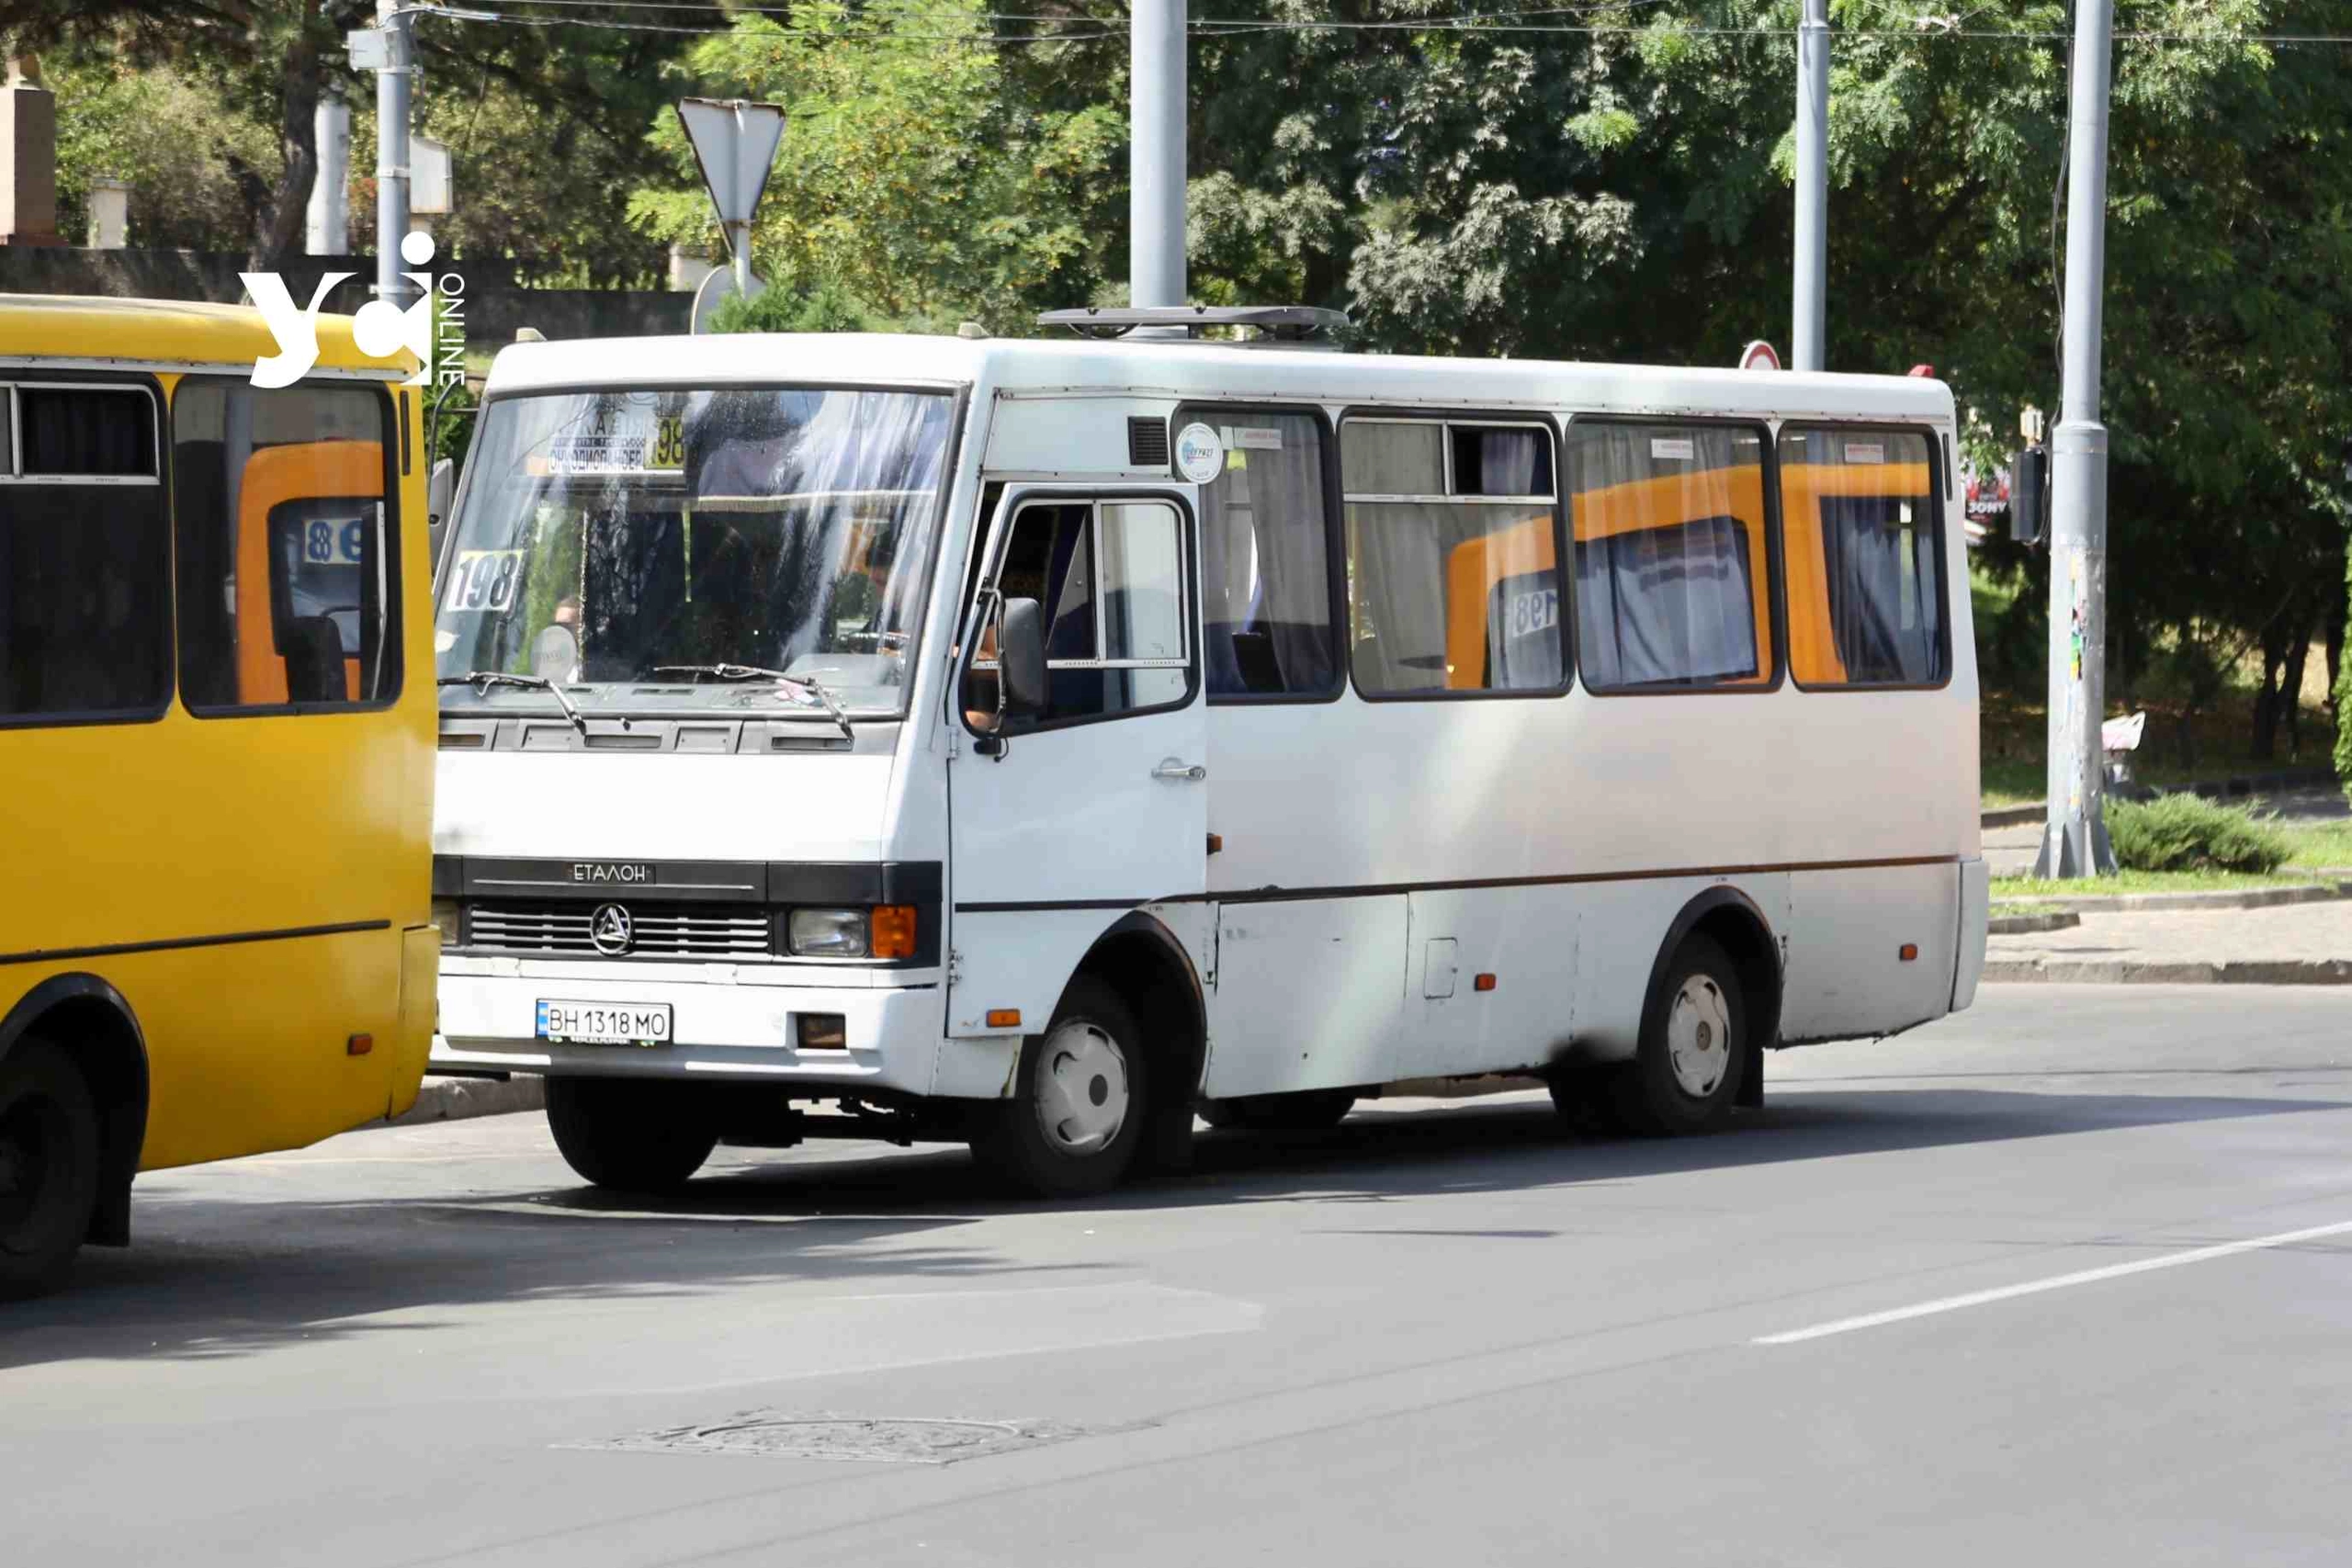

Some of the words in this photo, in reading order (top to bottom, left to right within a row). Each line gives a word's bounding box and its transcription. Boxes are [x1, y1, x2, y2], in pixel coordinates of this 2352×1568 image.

[455, 554, 518, 608] 198
[574, 864, 645, 881] ЕТАЛОН
[584, 1010, 629, 1034] 1318
